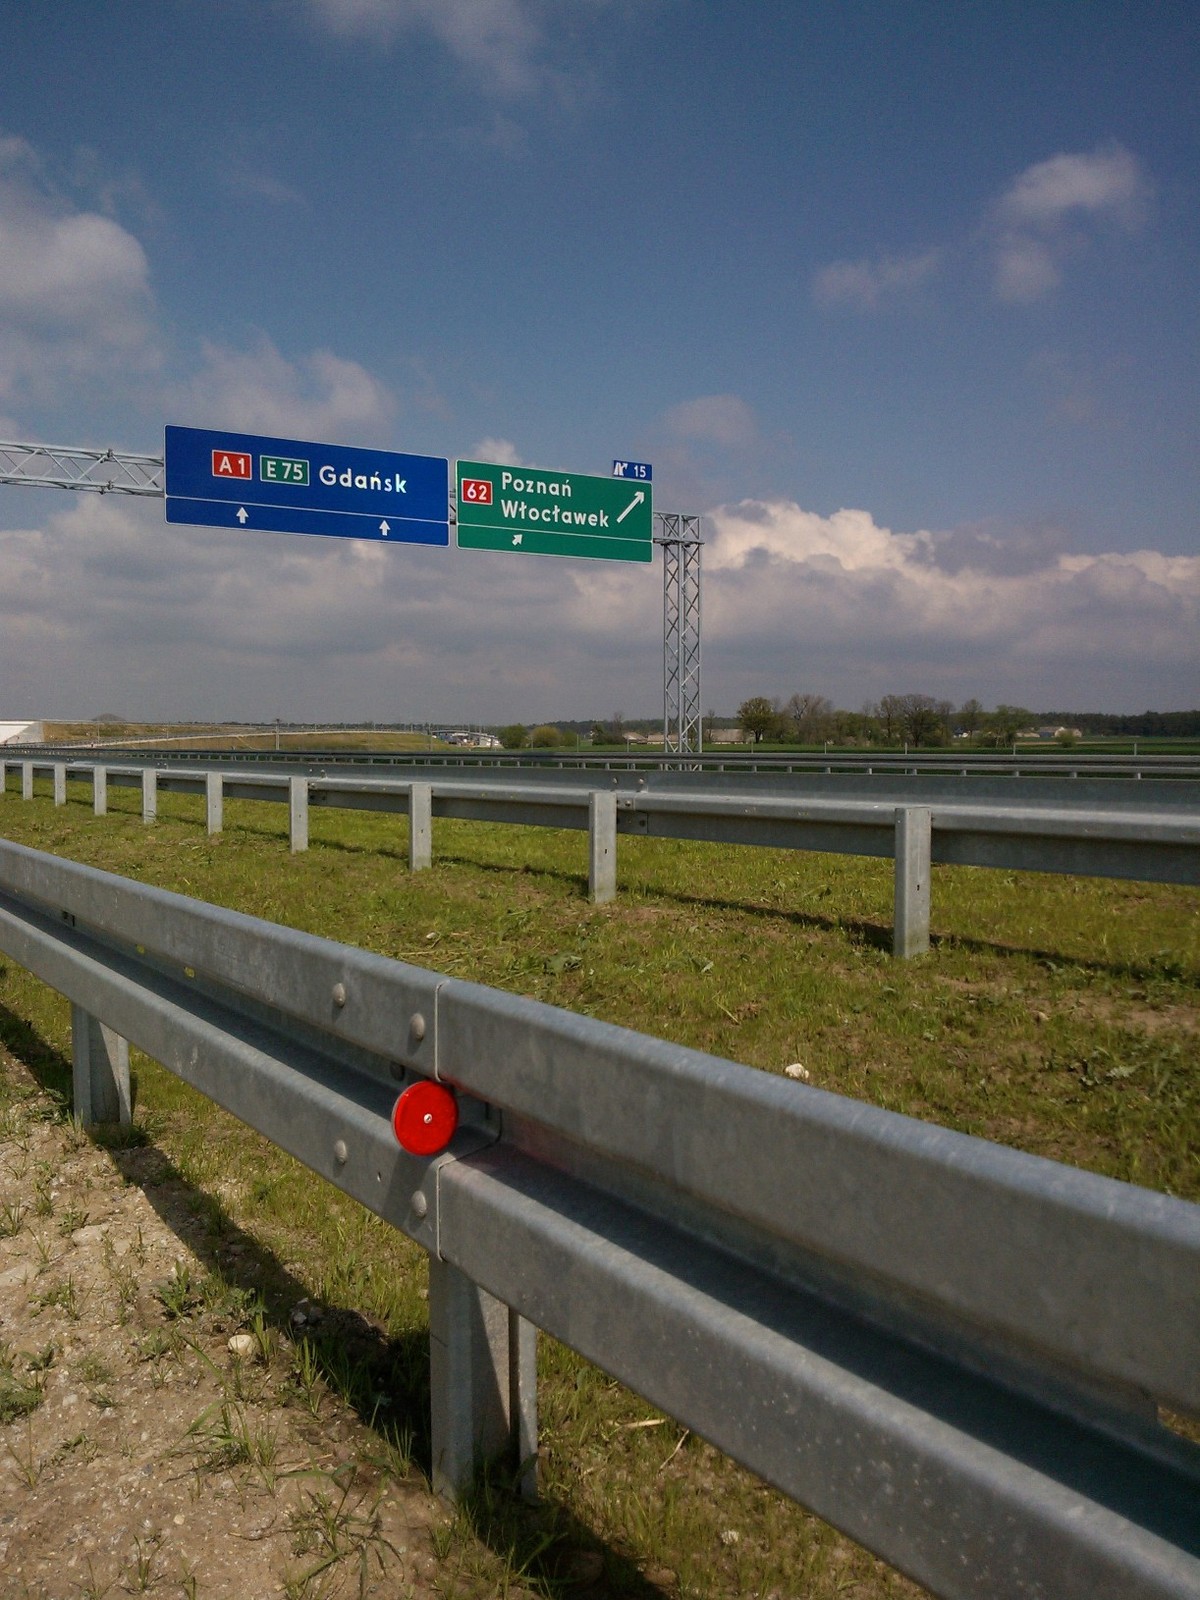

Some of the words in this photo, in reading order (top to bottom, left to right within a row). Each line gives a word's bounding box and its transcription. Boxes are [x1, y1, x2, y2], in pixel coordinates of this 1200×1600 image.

[319, 465, 407, 493] Gdańsk
[633, 465, 647, 478] 15
[466, 483, 487, 501] 62
[501, 472, 571, 497] Poznań
[501, 499, 609, 527] Włocławek
